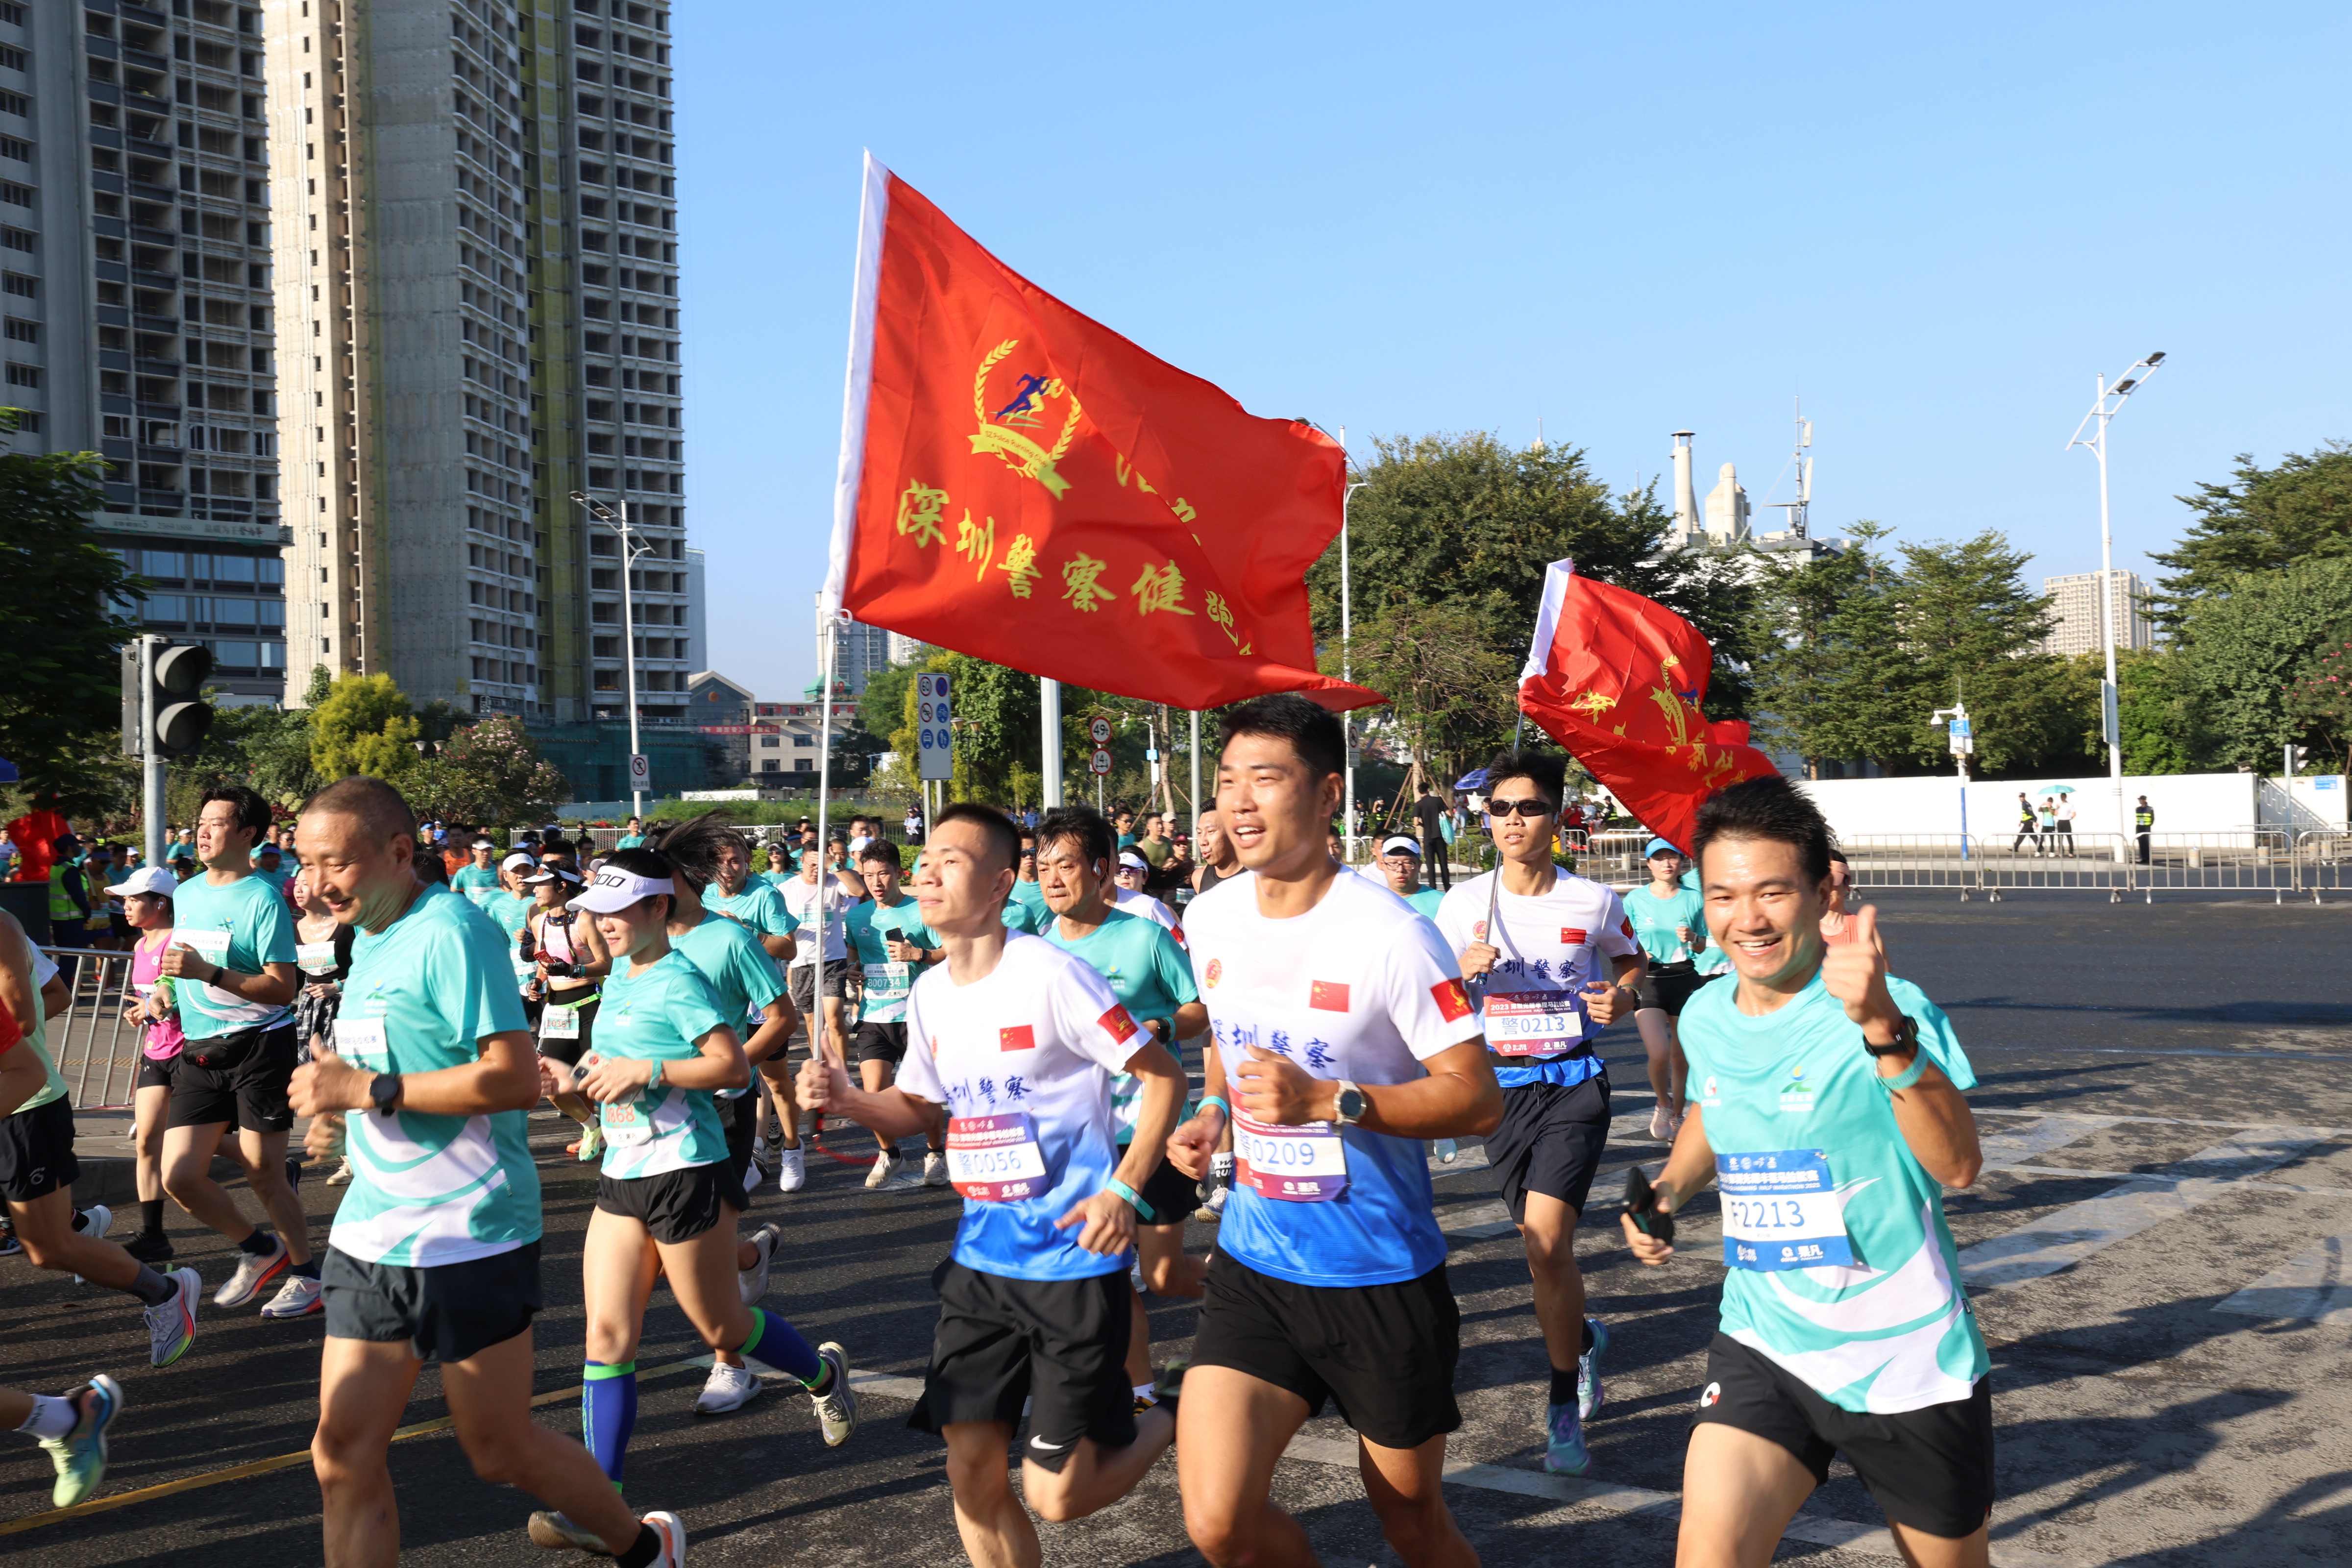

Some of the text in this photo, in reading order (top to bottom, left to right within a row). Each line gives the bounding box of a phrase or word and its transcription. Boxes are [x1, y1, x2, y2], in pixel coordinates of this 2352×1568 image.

[1493, 957, 1577, 980] 圳警察
[868, 978, 901, 987] B00734
[1511, 1001, 1571, 1010] 深圳光明半程马拉松赛
[1501, 1016, 1565, 1035] 警0213
